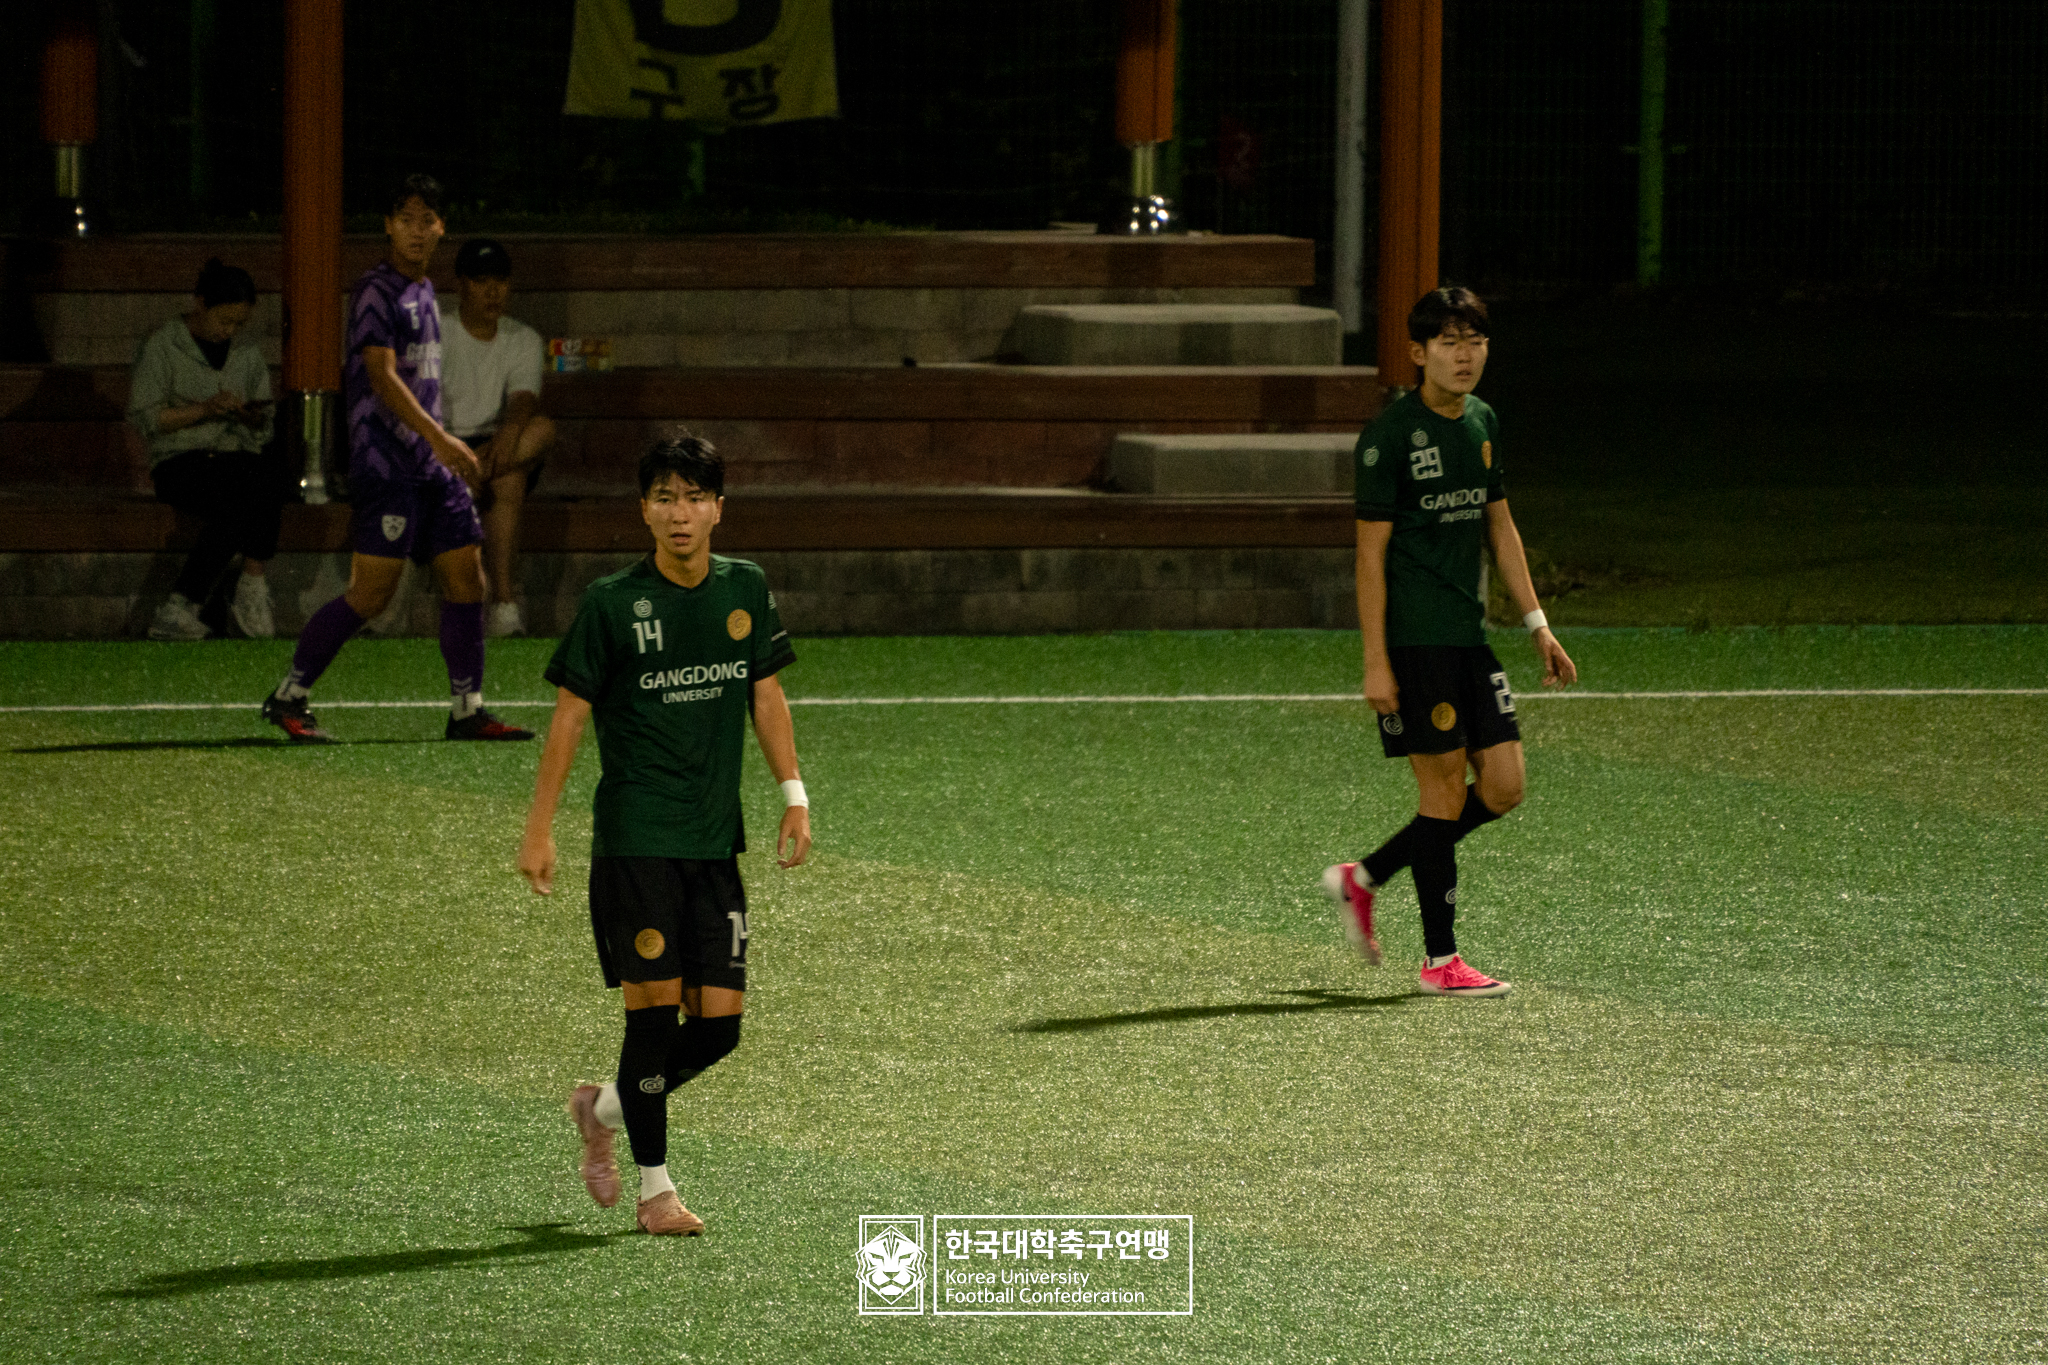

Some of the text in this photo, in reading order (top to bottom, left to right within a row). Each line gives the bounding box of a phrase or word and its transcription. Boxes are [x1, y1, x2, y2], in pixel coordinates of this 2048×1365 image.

[1409, 446, 1444, 480] 29
[631, 619, 663, 654] 14
[639, 660, 748, 690] GANGDONG
